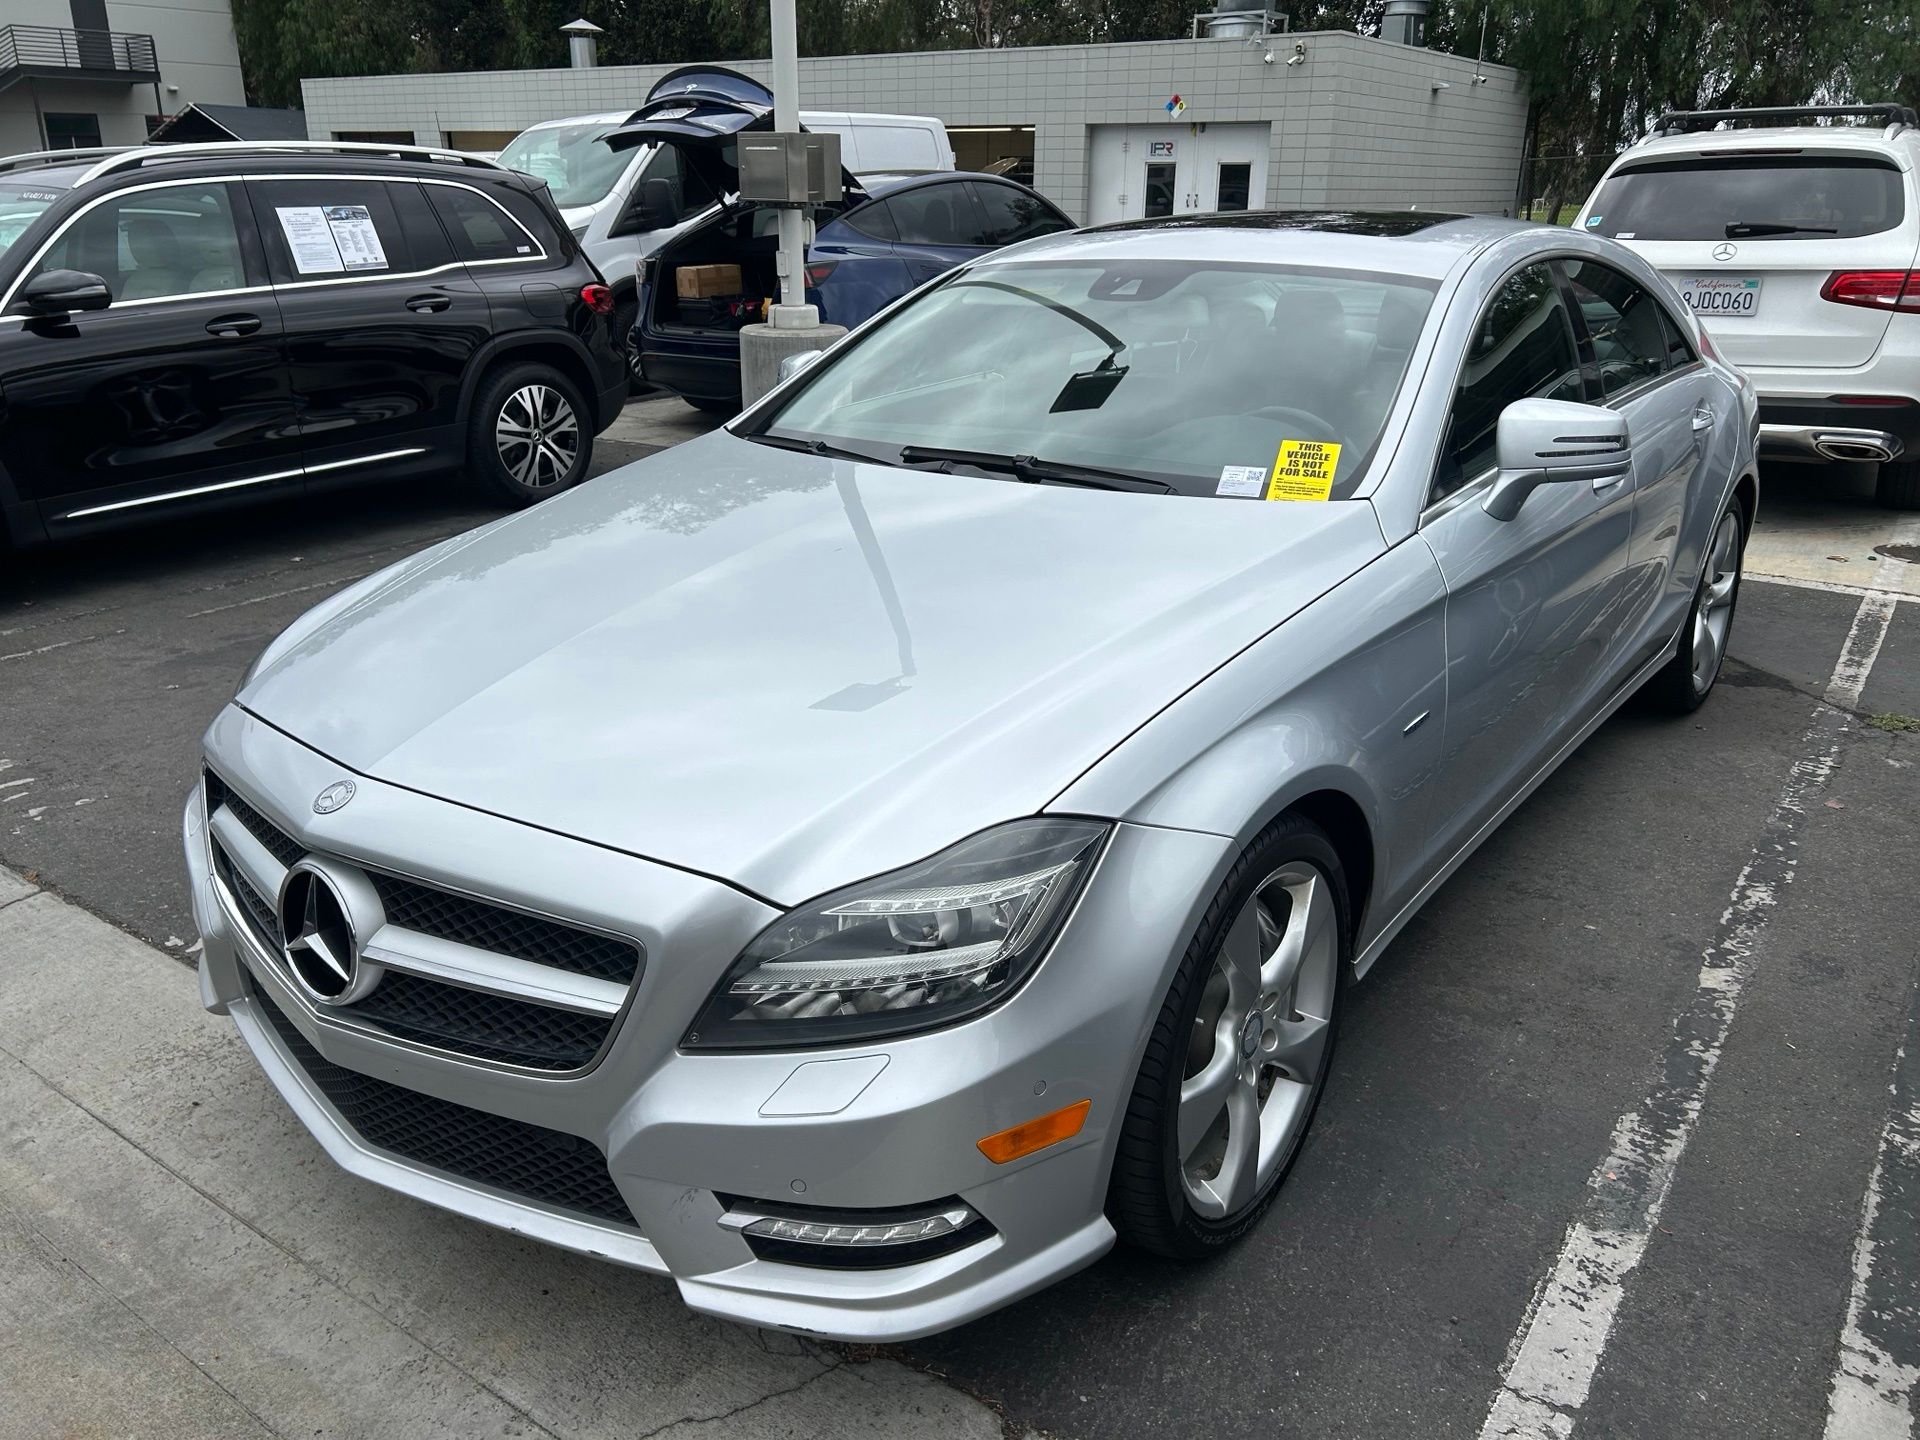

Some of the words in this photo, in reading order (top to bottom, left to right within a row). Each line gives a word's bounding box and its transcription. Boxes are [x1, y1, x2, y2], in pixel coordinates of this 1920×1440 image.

[1150, 143, 1173, 153] IPR
[1696, 279, 1742, 291] California
[1298, 443, 1323, 452] THIS
[1287, 450, 1331, 461] VEHICLE
[1288, 459, 1300, 467] IS
[1302, 461, 1324, 469] NOT
[1279, 468, 1300, 476] FOR
[1303, 470, 1328, 478] SALE
